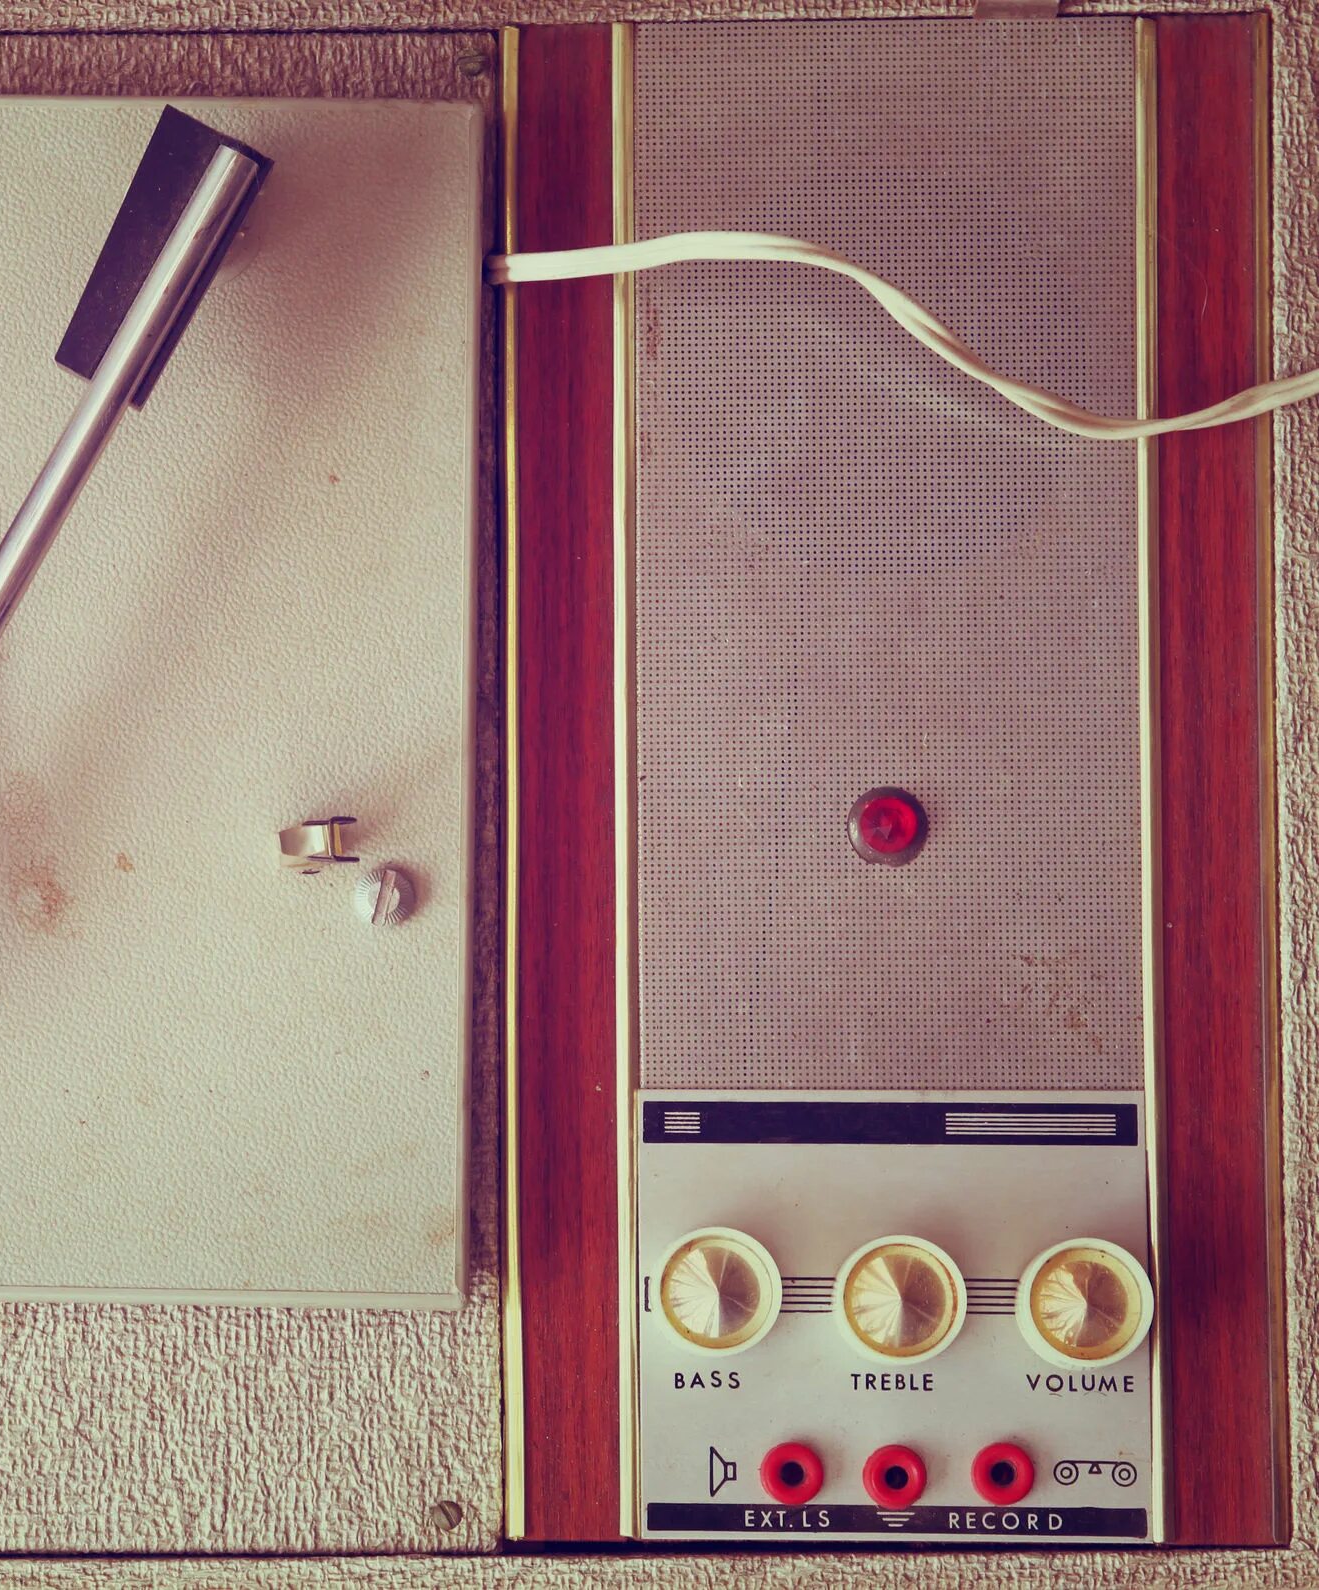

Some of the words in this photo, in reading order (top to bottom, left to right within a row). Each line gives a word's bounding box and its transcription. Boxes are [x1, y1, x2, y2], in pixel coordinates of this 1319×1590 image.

[673, 1370, 741, 1390] BASS
[850, 1372, 935, 1392] TREBLE
[1025, 1374, 1135, 1393] VOLUME
[801, 1510, 831, 1529] LS
[948, 1512, 1064, 1531] RECORD
